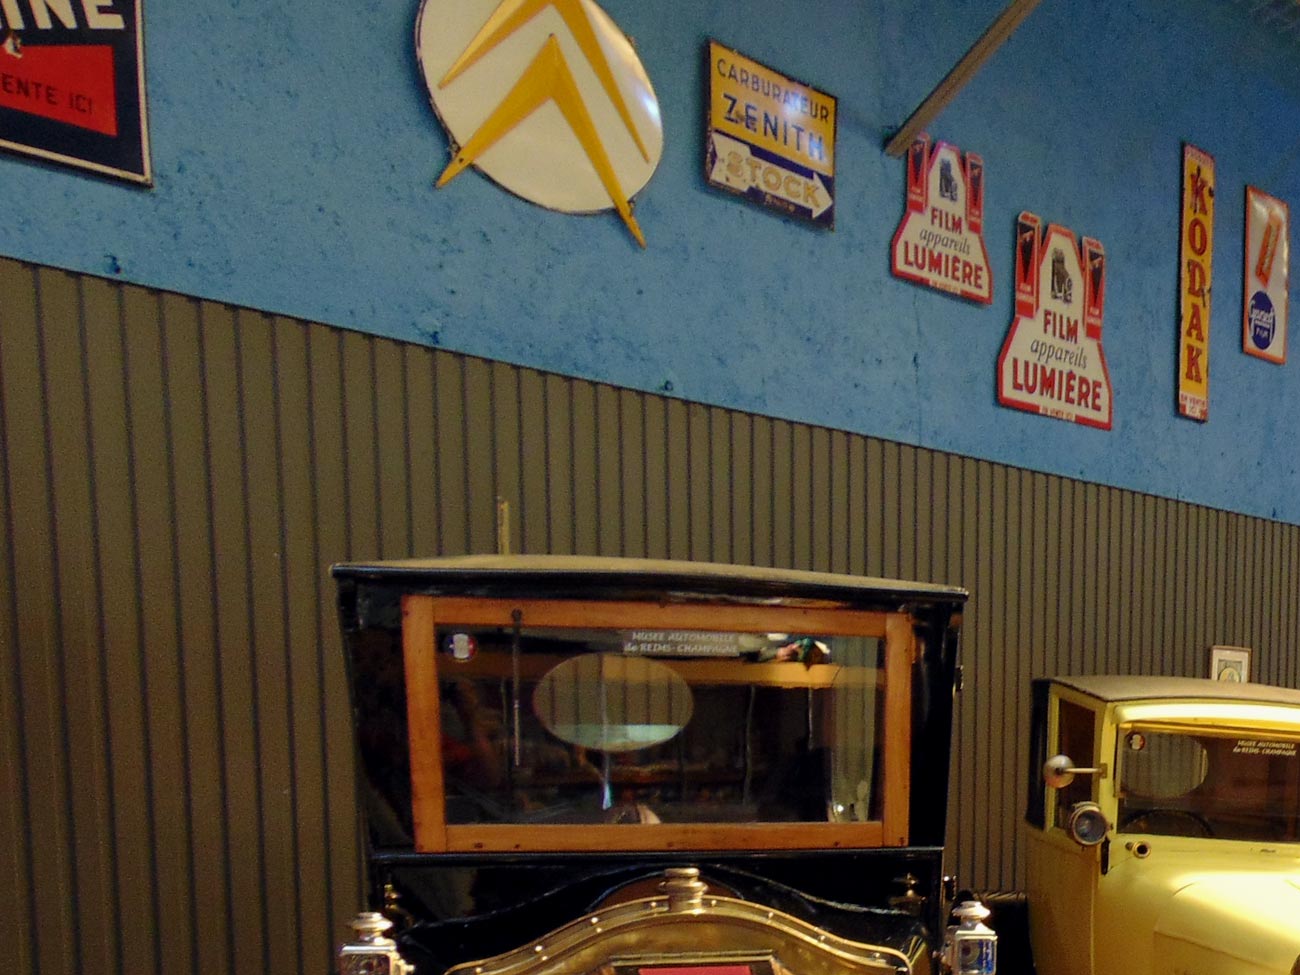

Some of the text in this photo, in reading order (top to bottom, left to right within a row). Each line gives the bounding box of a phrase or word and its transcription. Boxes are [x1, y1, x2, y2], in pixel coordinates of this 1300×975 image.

[68, 92, 93, 115] ICI
[717, 58, 829, 124] CARBURATEUR
[723, 92, 824, 161] ZENITH
[726, 151, 820, 209] STOCK
[930, 206, 963, 235] FILM
[919, 228, 970, 256] appareils
[1185, 172, 1208, 384] KODAK
[1043, 309, 1079, 345] FILM
[1030, 338, 1088, 370] appareils
